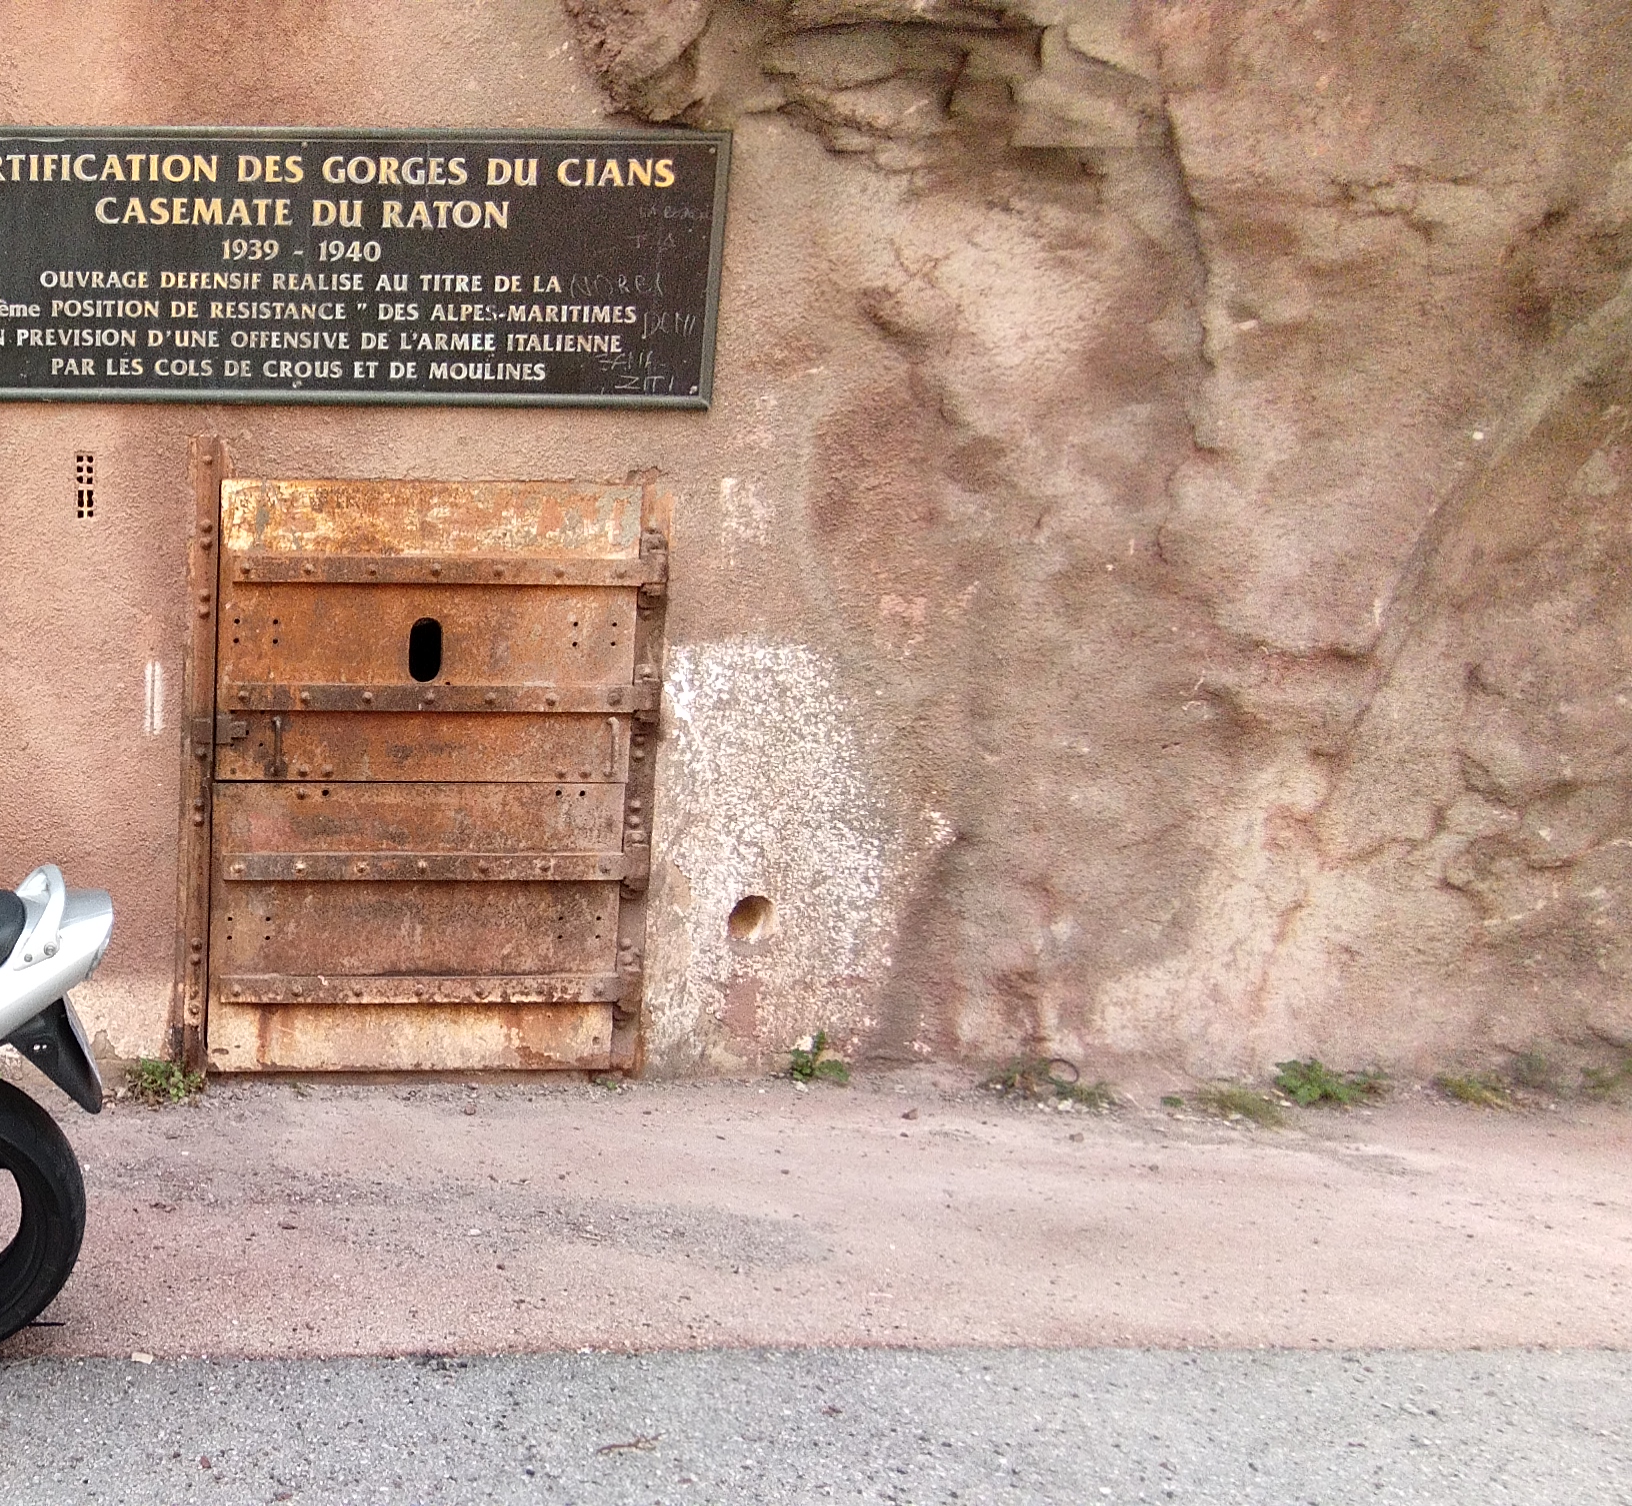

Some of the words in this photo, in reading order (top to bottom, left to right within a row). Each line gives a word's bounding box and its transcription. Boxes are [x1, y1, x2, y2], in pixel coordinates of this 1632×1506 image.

[237, 155, 305, 184] DES
[321, 156, 468, 187] GORGES
[486, 158, 538, 187] DU
[556, 158, 676, 189] CIANS
[95, 196, 293, 227] CASEMATE
[311, 199, 364, 228] DU
[381, 200, 510, 230] RATON
[221, 239, 280, 261] 1939
[318, 240, 382, 263] 1940
[39, 270, 150, 289] OUVRAGE
[160, 271, 262, 290] DEFENSIF
[272, 273, 365, 292] REALISE
[374, 273, 409, 292] AU
[419, 274, 483, 292] TITRE
[493, 275, 523, 293] DE
[533, 275, 562, 293] LA
[51, 299, 160, 319] POSITION
[170, 300, 199, 319] DE
[209, 301, 347, 321] RESISTANCE
[377, 302, 420, 321] DES
[430, 303, 637, 324] ALPES-MARITIMES
[16, 328, 137, 347] PREVISION
[147, 329, 220, 348] D'UNE
[230, 331, 350, 350] OFFENSIVE
[360, 332, 390, 350] DE
[399, 332, 496, 352] L'ARMEE
[506, 333, 623, 353] ITALIENNE
[51, 357, 96, 376] PAR
[106, 358, 144, 377] LES
[153, 358, 214, 377] COLS
[223, 359, 252, 378] DE
[262, 360, 344, 379] CROUS
[353, 361, 379, 380] ET
[389, 361, 418, 380] DE
[428, 362, 546, 382] MOULINES
